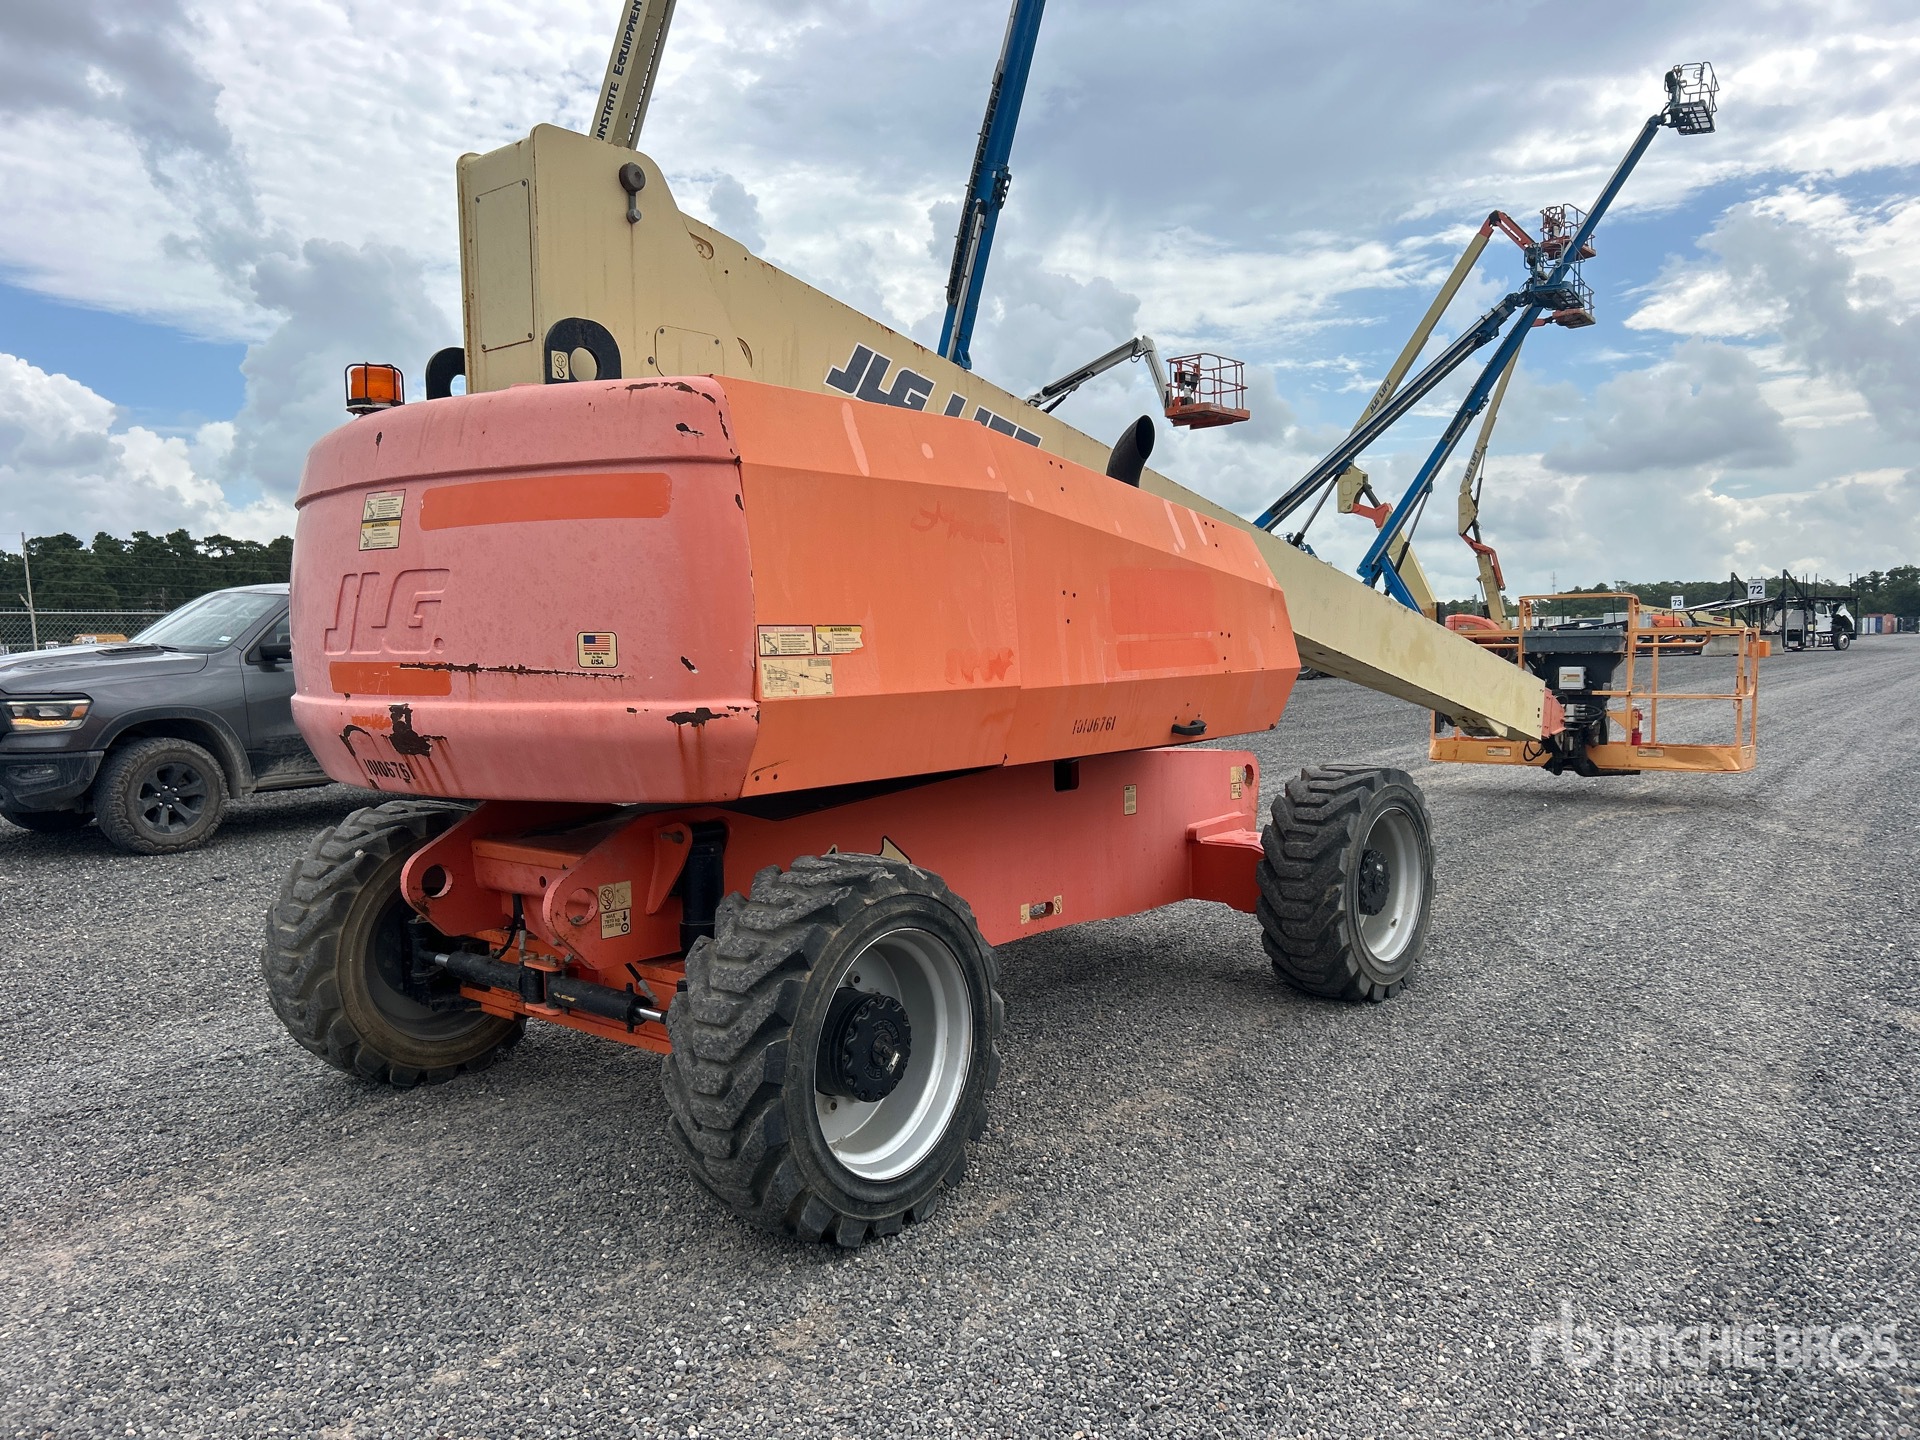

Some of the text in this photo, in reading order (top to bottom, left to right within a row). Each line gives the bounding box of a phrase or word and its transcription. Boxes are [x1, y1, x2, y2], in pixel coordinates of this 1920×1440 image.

[823, 341, 936, 412] JLG
[1370, 379, 1391, 414] JLG LIFT
[1465, 449, 1480, 481] JLG LIFT
[1672, 599, 1682, 607] 73
[1749, 585, 1763, 595] 72
[324, 568, 451, 656] JLG
